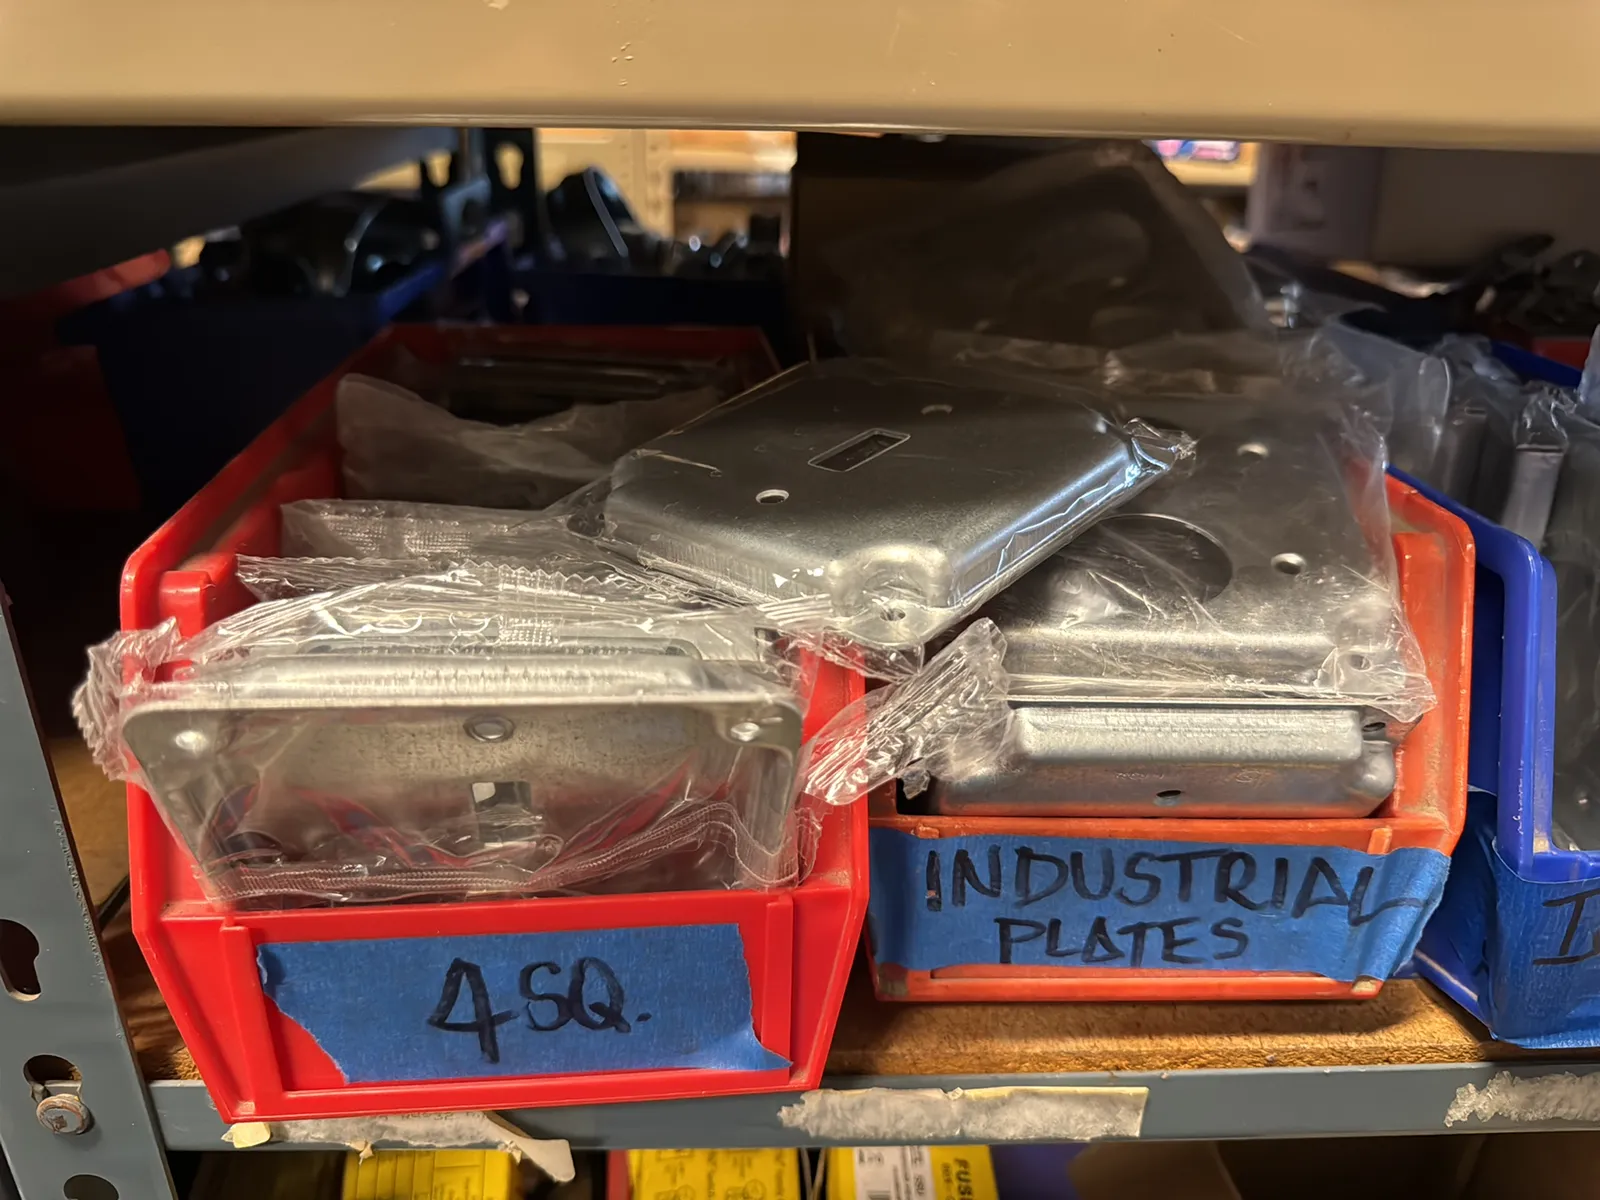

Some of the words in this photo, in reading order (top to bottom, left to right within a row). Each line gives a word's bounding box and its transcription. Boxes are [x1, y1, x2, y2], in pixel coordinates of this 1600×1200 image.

[926, 844, 1432, 927] INDUSTRIAL
[994, 916, 1249, 968] PLATES
[427, 957, 519, 1064] 4
[518, 956, 652, 1034] SQ.
